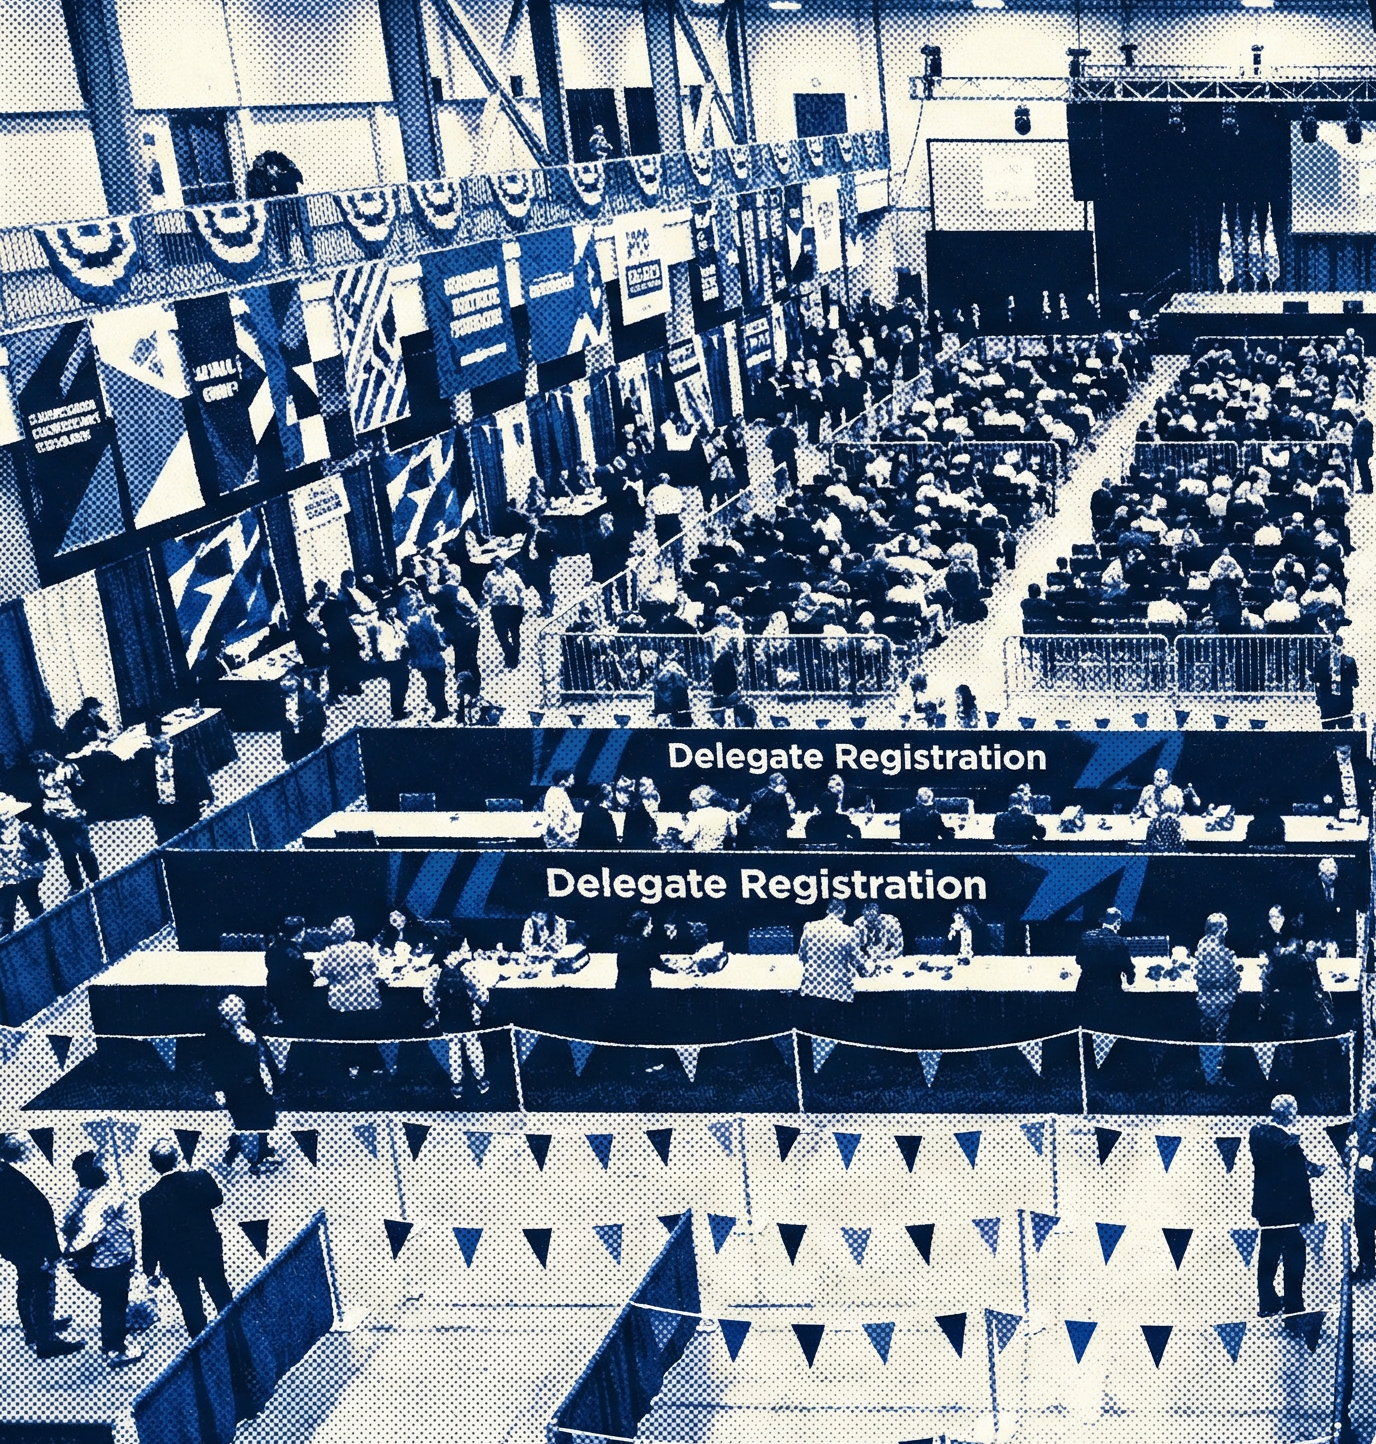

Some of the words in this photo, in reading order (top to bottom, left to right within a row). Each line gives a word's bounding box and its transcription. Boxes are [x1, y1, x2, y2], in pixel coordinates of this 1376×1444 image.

[668, 742, 824, 775] Delegate
[835, 743, 1047, 776] Registration
[546, 866, 727, 905] Delegate
[740, 868, 987, 905] Registration
